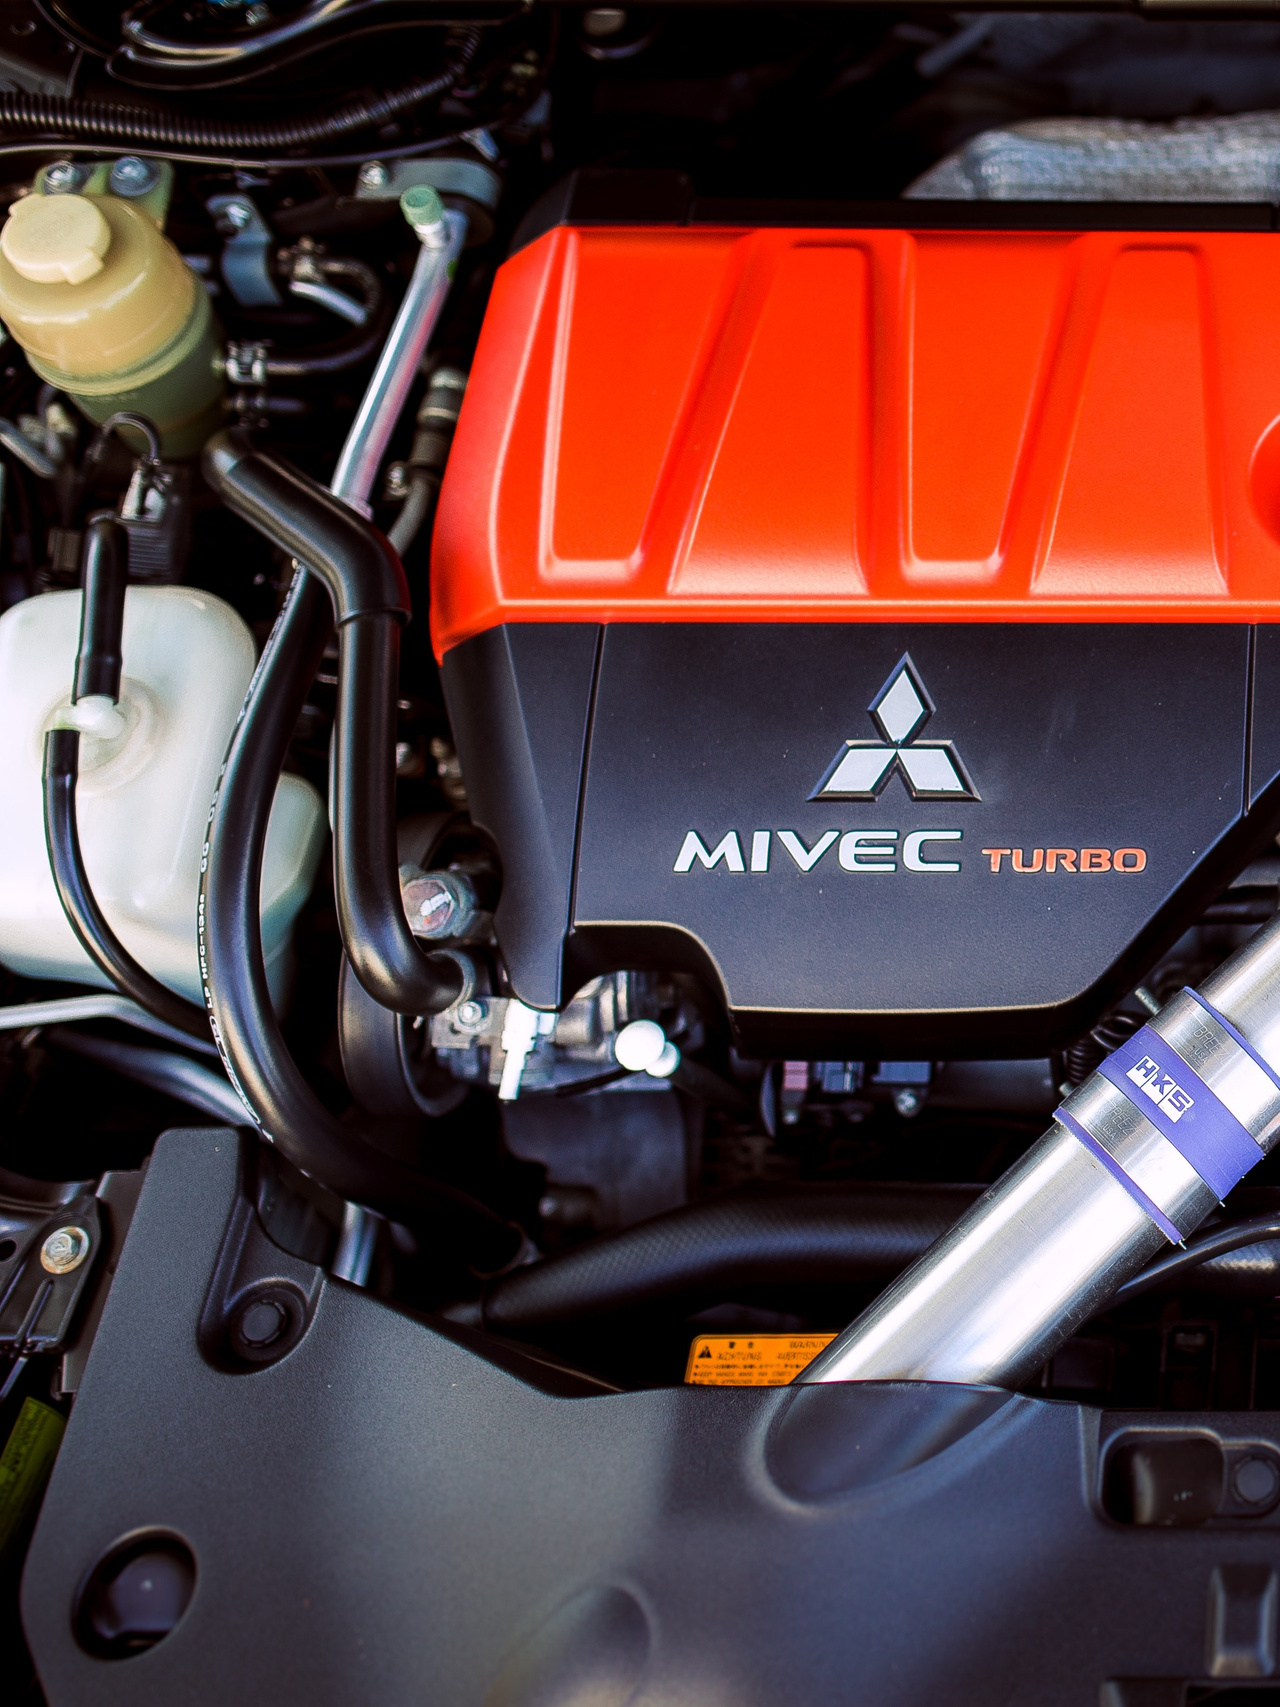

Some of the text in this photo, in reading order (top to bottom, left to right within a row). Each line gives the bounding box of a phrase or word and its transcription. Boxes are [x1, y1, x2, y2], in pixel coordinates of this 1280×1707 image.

[673, 829, 1147, 873] MIVEC TURBO
[1135, 1058, 1191, 1113] HKS
